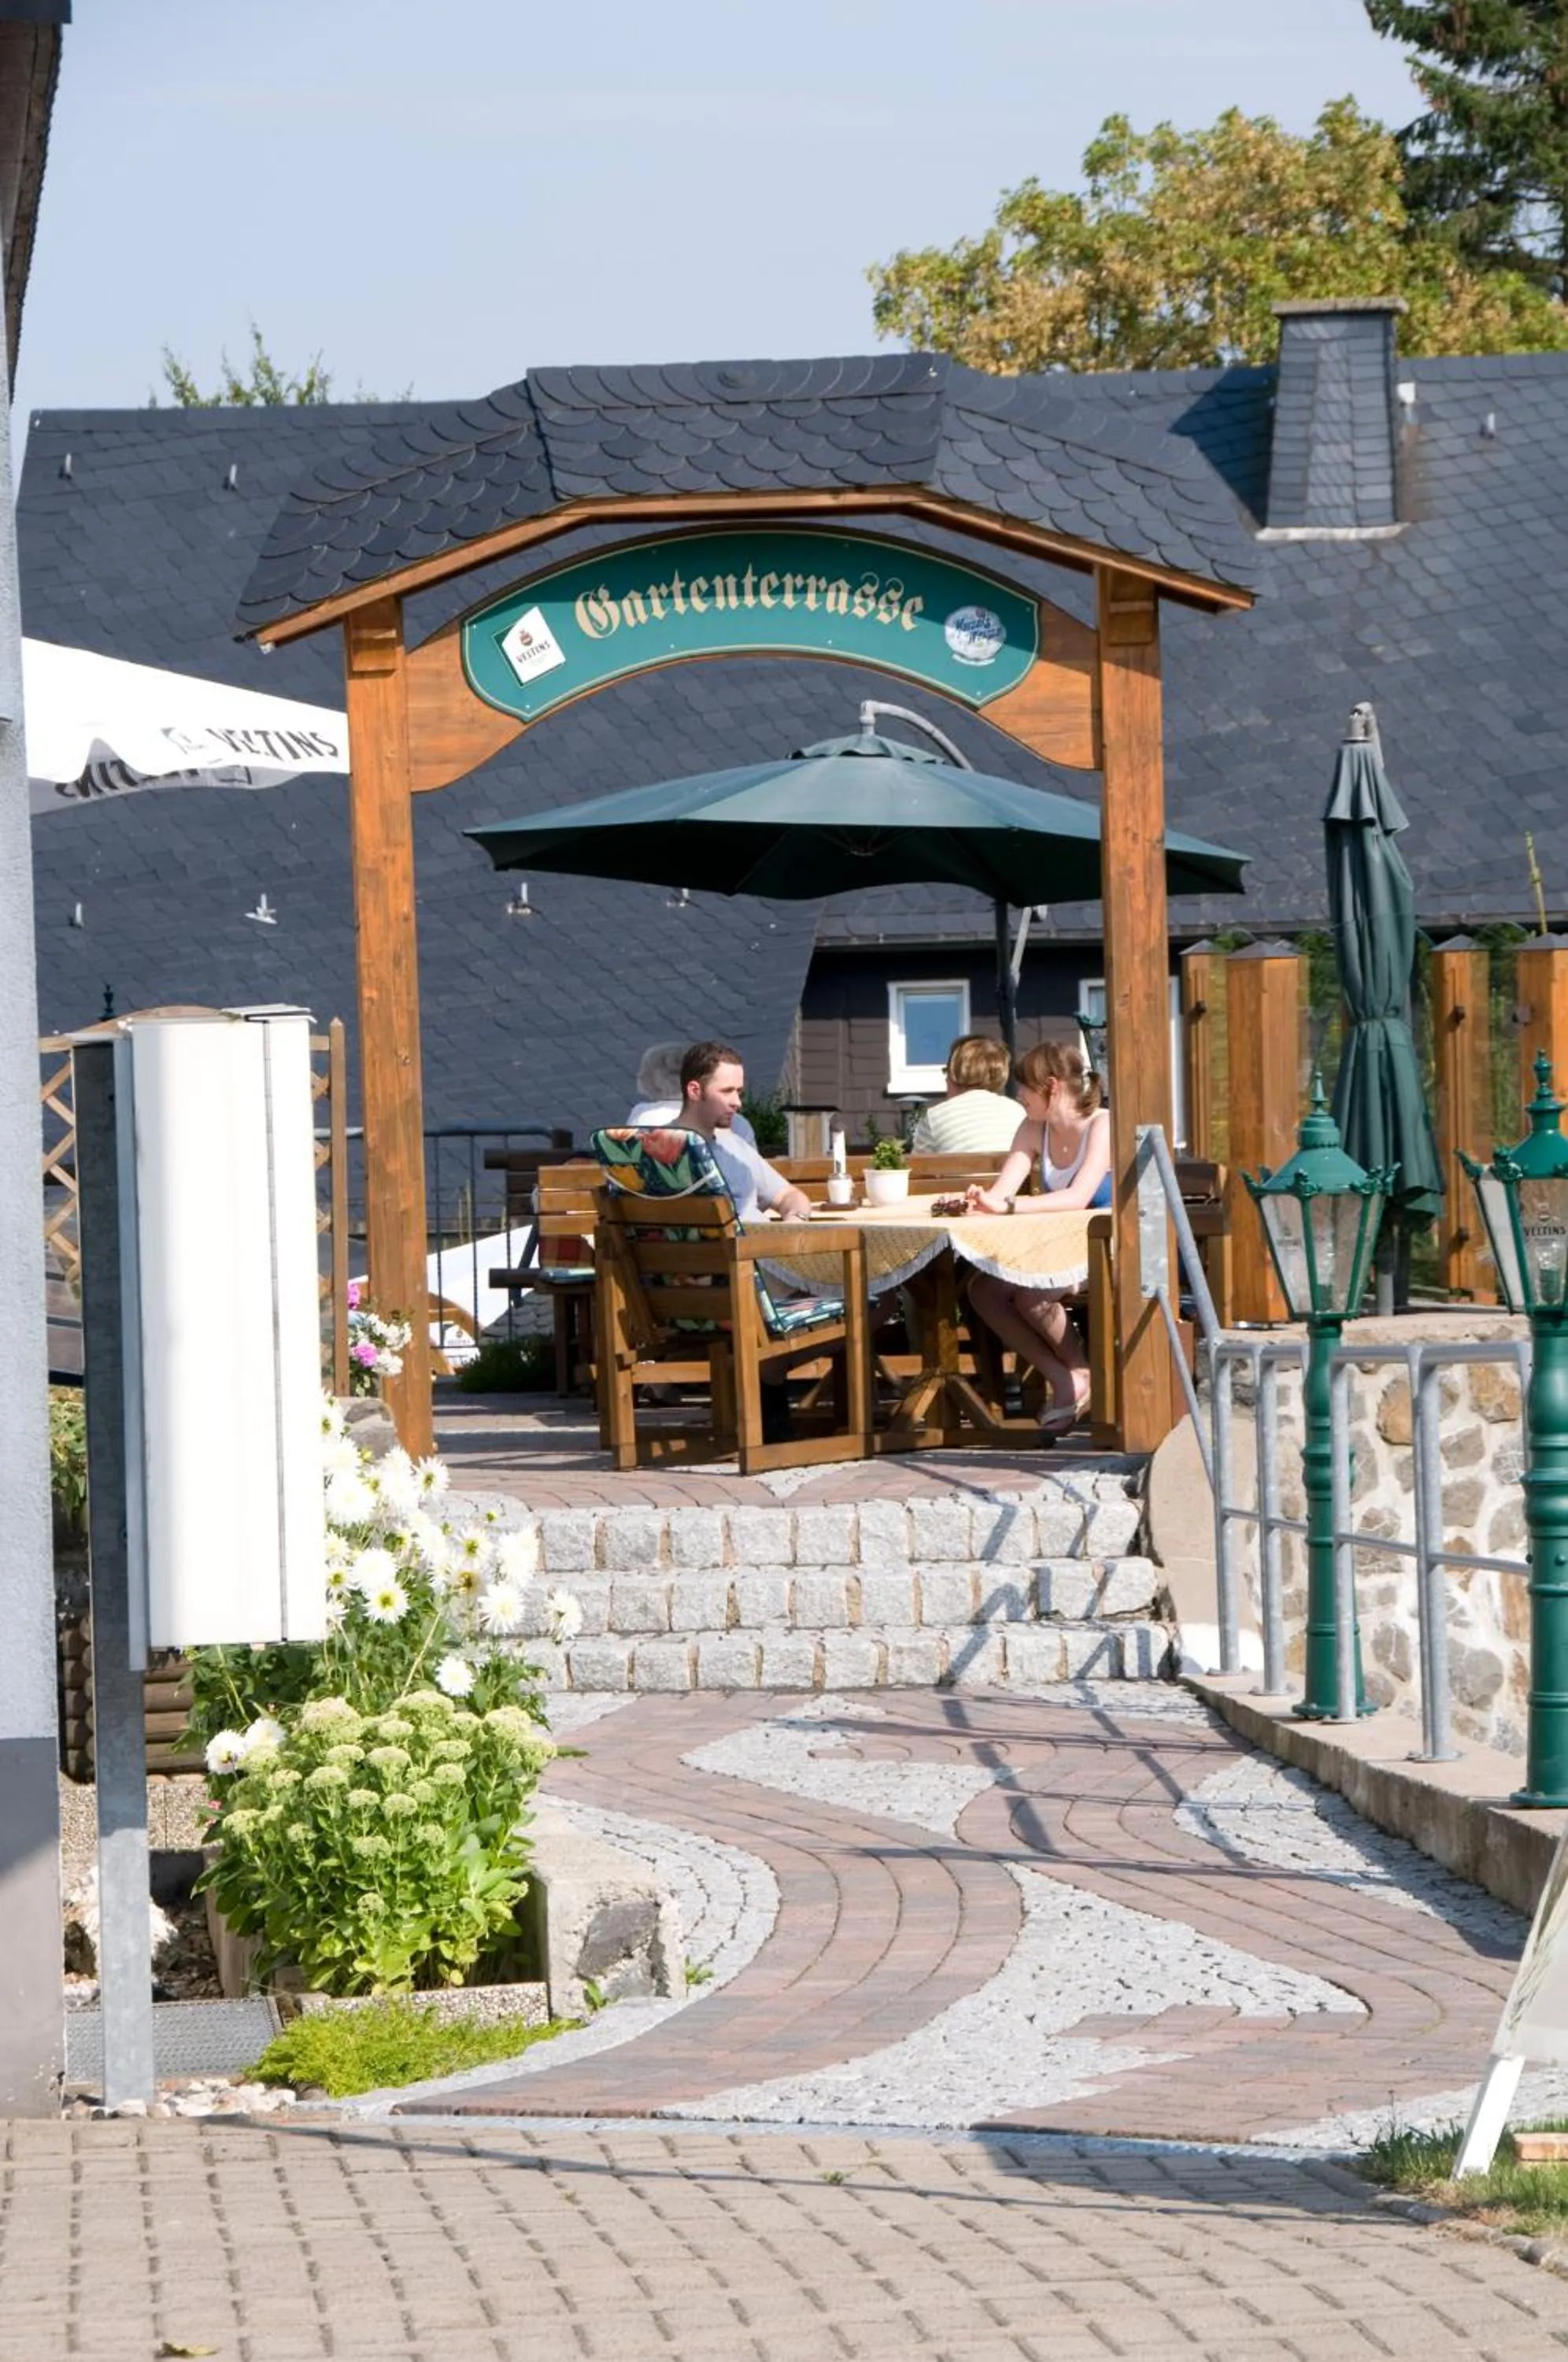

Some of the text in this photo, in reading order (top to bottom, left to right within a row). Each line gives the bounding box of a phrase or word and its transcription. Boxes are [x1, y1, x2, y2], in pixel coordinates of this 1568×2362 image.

[575, 563, 926, 639] Gartenterrasse
[516, 640, 551, 664] VELTINS
[205, 727, 339, 761] VELTINS
[1523, 1226, 1566, 1237] VELTINS
